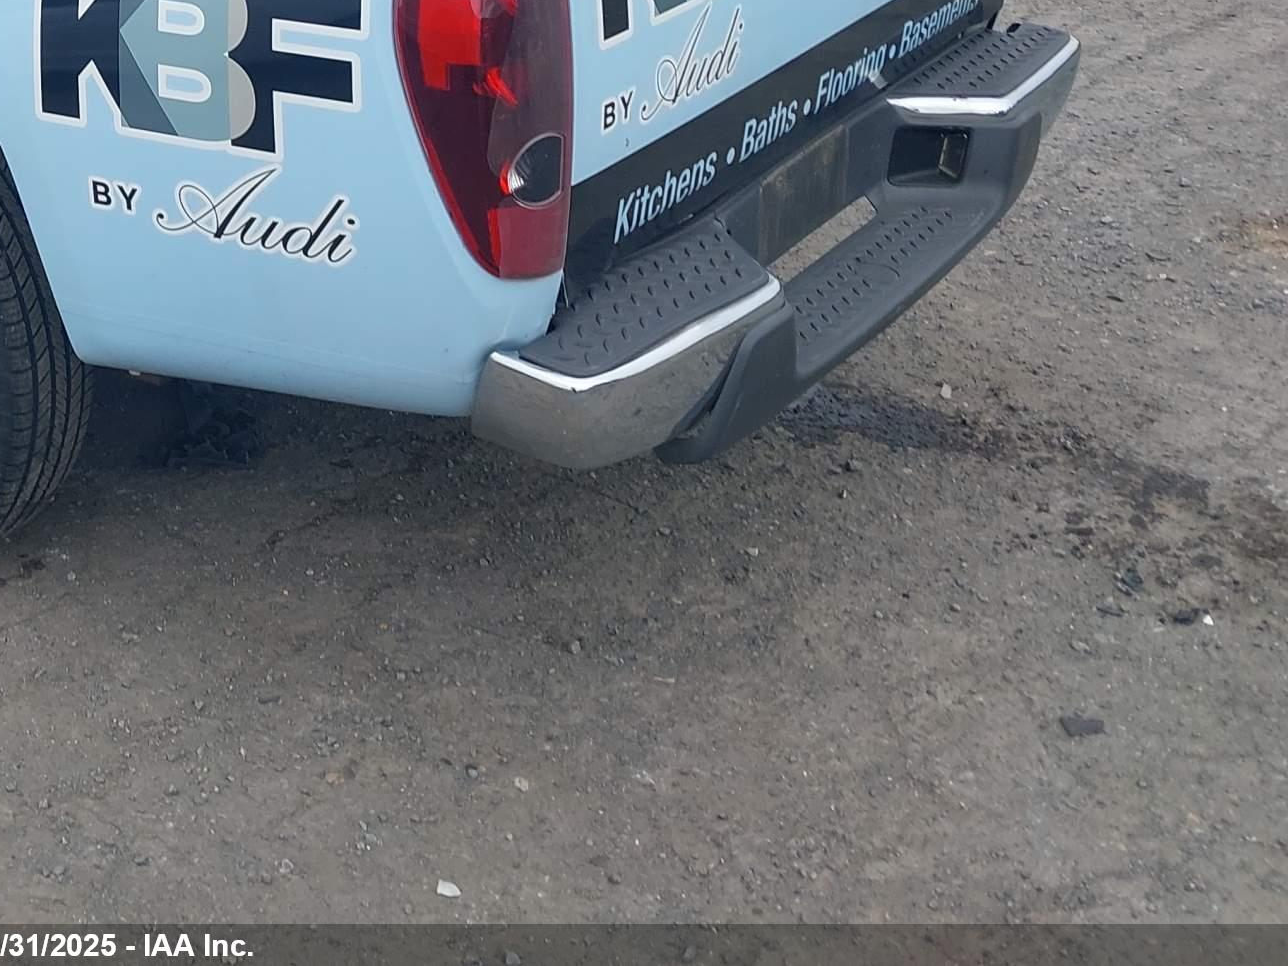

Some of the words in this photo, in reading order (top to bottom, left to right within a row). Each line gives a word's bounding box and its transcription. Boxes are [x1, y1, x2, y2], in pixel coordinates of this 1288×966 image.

[603, 91, 633, 130] BY
[641, 4, 743, 121] Audi
[614, 151, 717, 245] Kitchens
[739, 98, 797, 162] Baths
[814, 43, 887, 115] Flooring
[91, 180, 138, 211] BY
[156, 168, 355, 263] Audi
